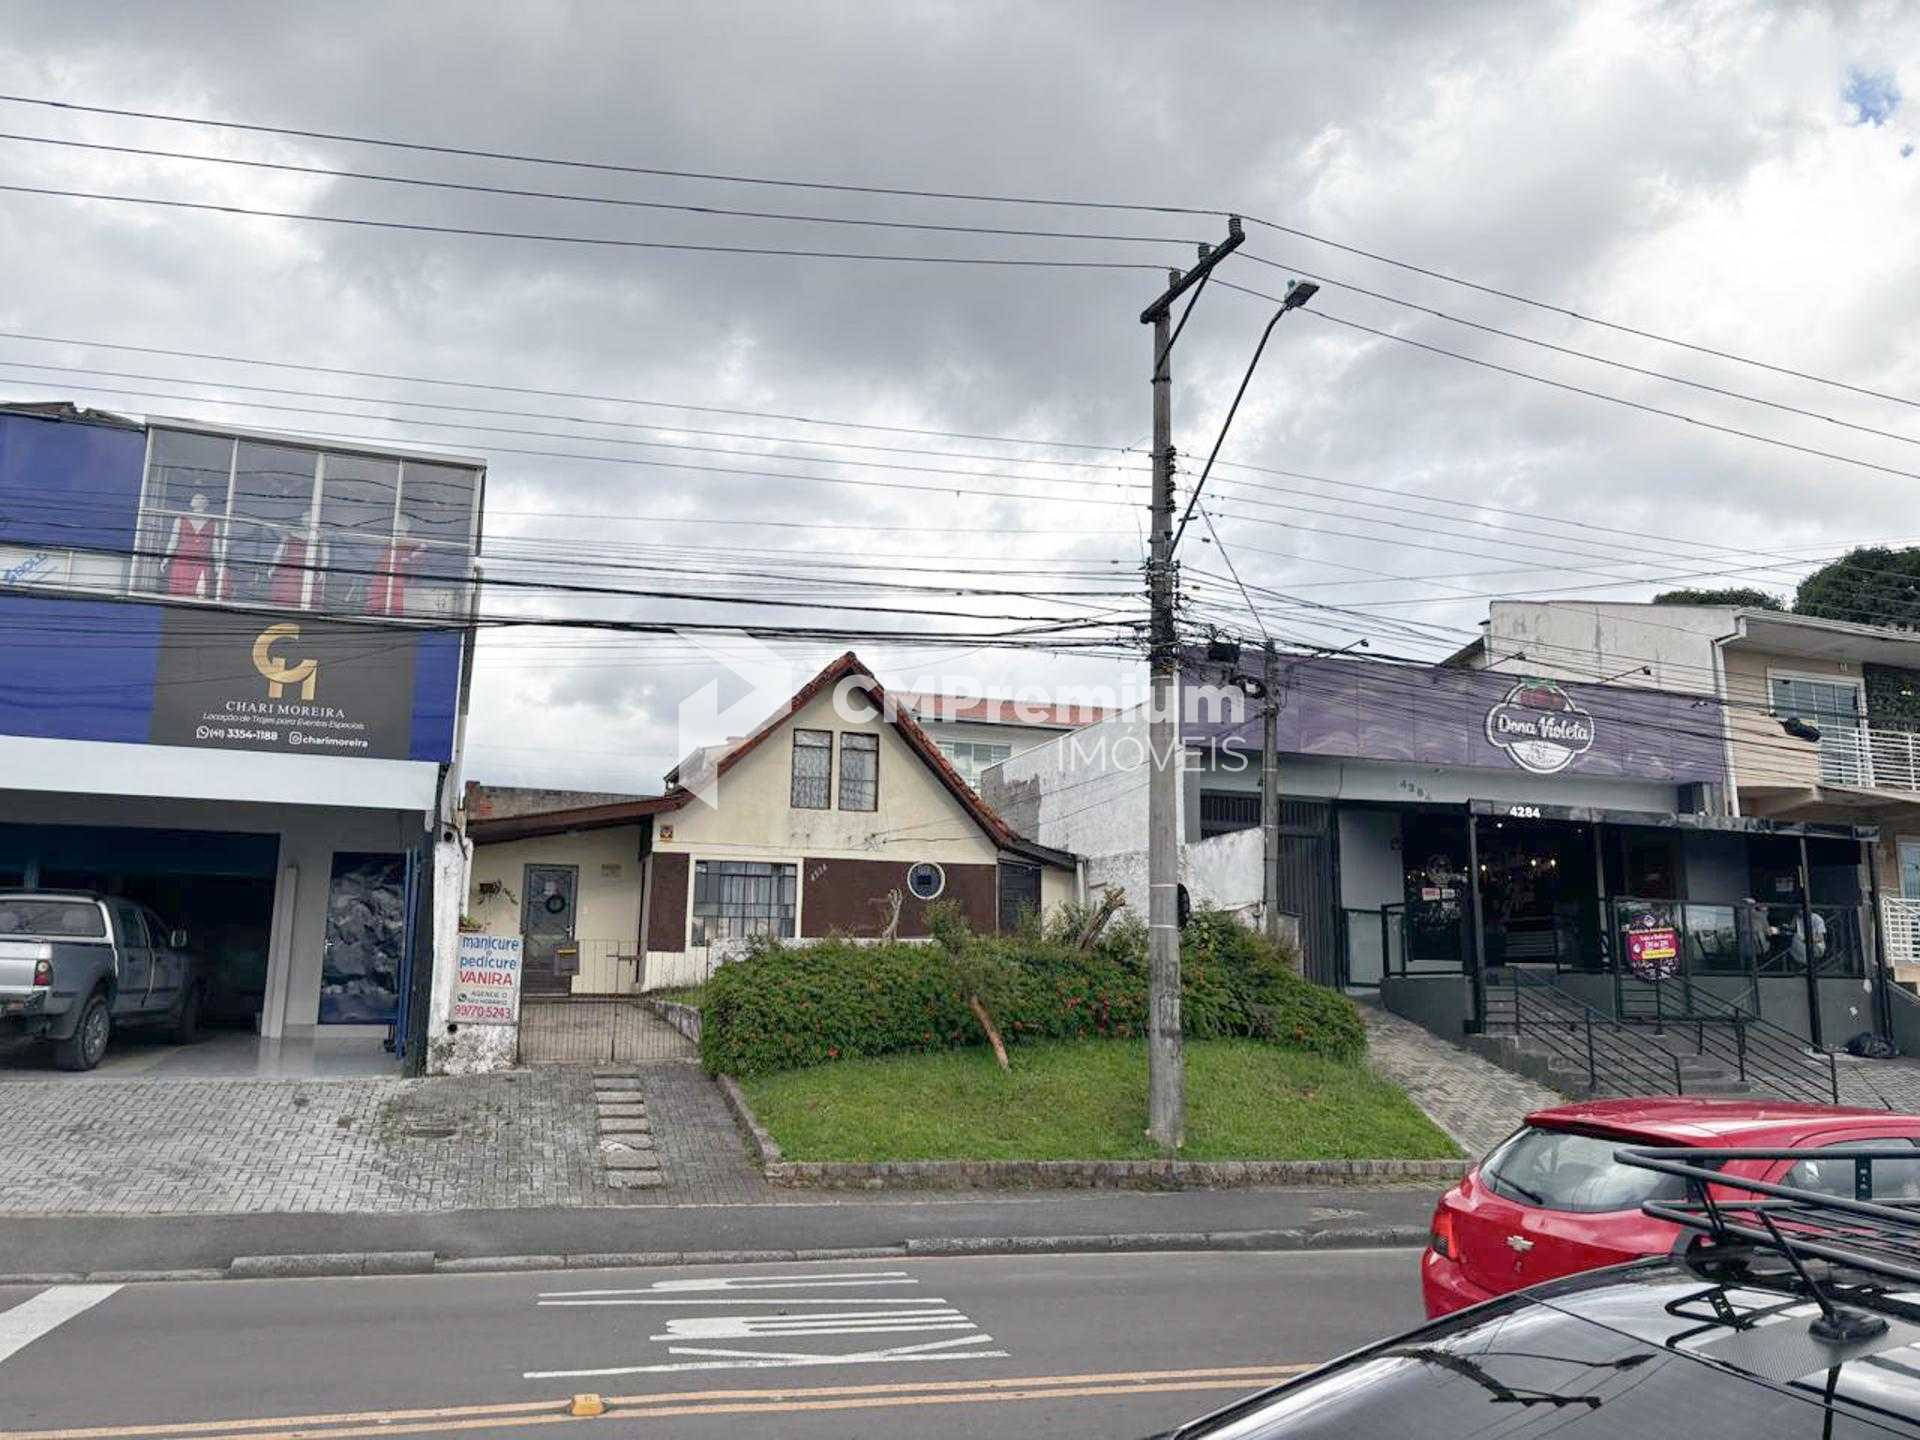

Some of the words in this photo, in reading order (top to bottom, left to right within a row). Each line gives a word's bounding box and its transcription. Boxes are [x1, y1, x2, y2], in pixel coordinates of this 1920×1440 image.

[226, 701, 273, 713] CHARI
[278, 706, 345, 718] MOREIRA
[1498, 714, 1537, 735] Dona
[1538, 716, 1588, 741] Violeta
[227, 728, 278, 741] 3354-1188
[302, 735, 368, 748] charimoreira
[1509, 806, 1541, 819] 4284
[463, 936, 519, 950] manicure
[460, 957, 517, 970] pedicure
[459, 971, 513, 986] VANIRA
